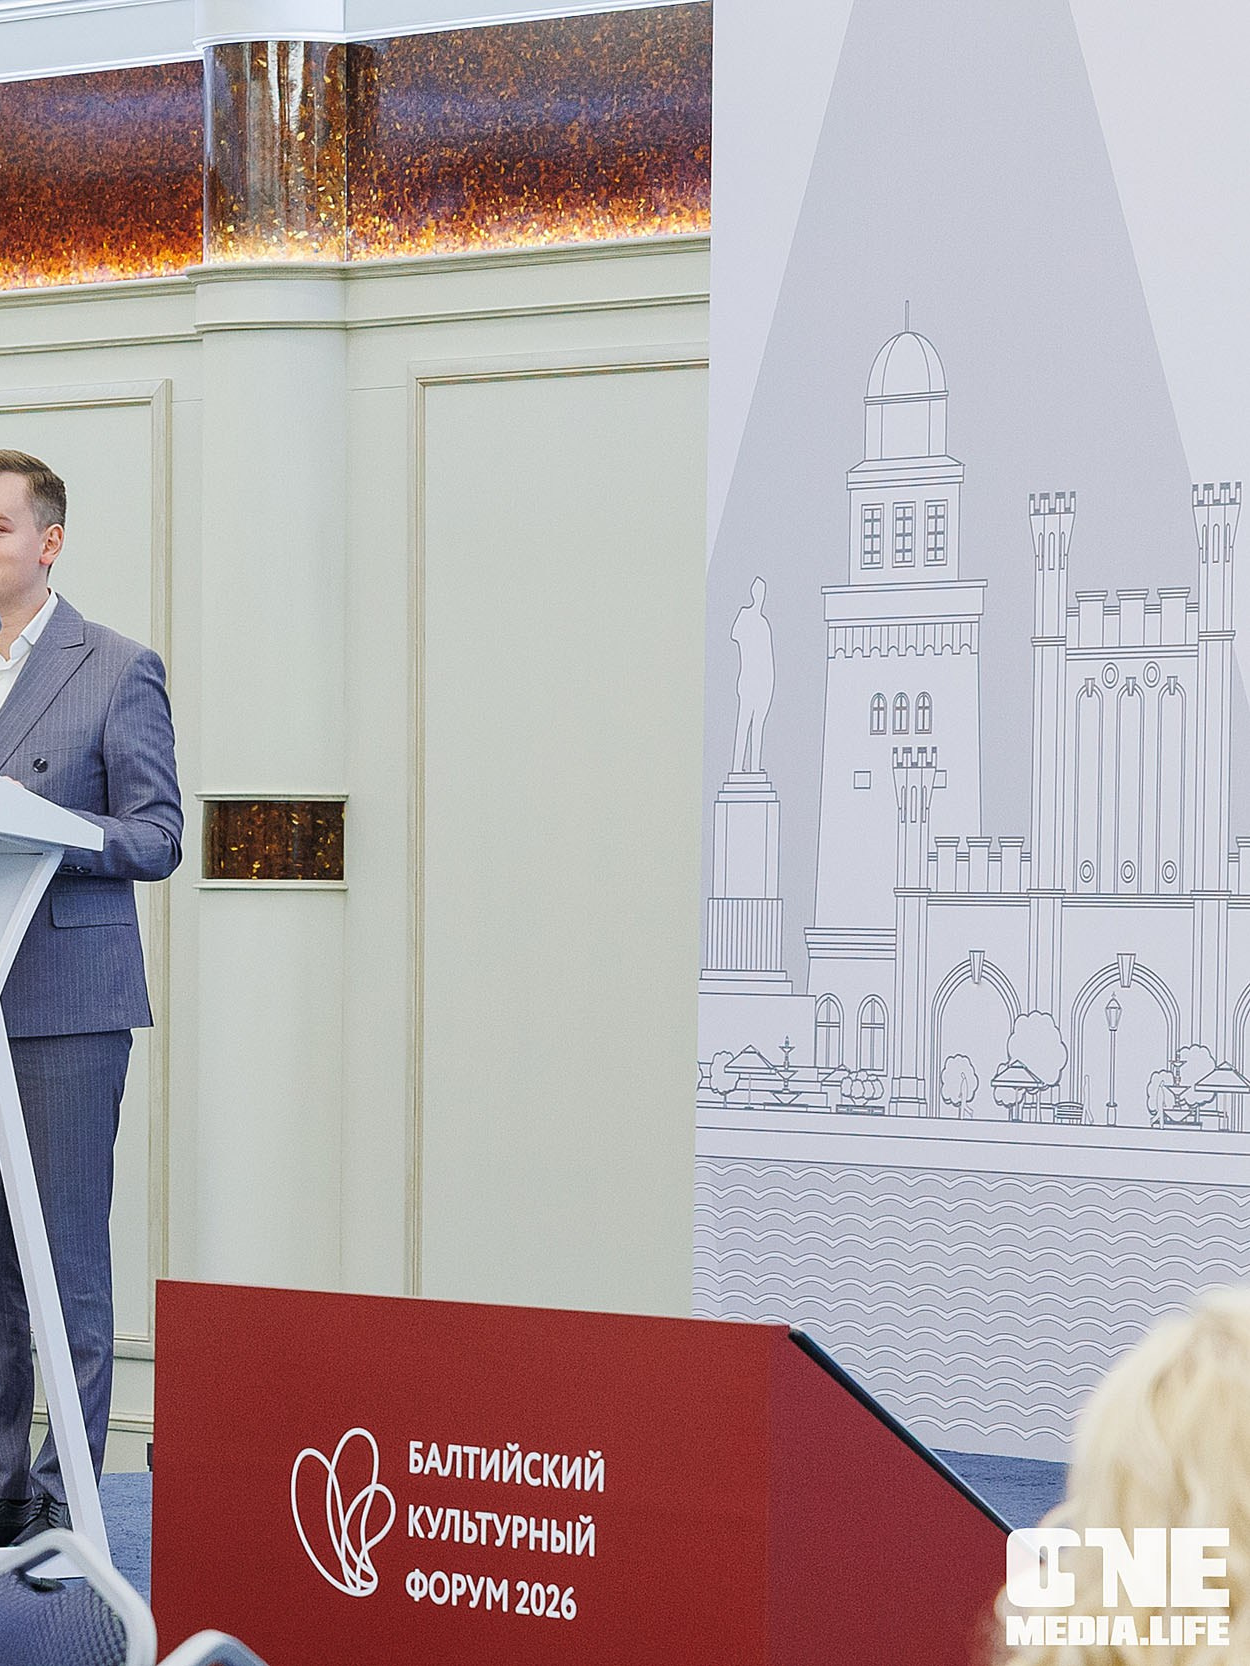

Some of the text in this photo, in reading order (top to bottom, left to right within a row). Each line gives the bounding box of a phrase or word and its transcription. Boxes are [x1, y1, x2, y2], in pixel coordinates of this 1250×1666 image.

[408, 1440, 605, 1493] БАЛТИЙСКИЙ
[407, 1504, 596, 1557] КУЛЬТУРНЫЙ
[405, 1568, 577, 1621] ФОРУМ 2026
